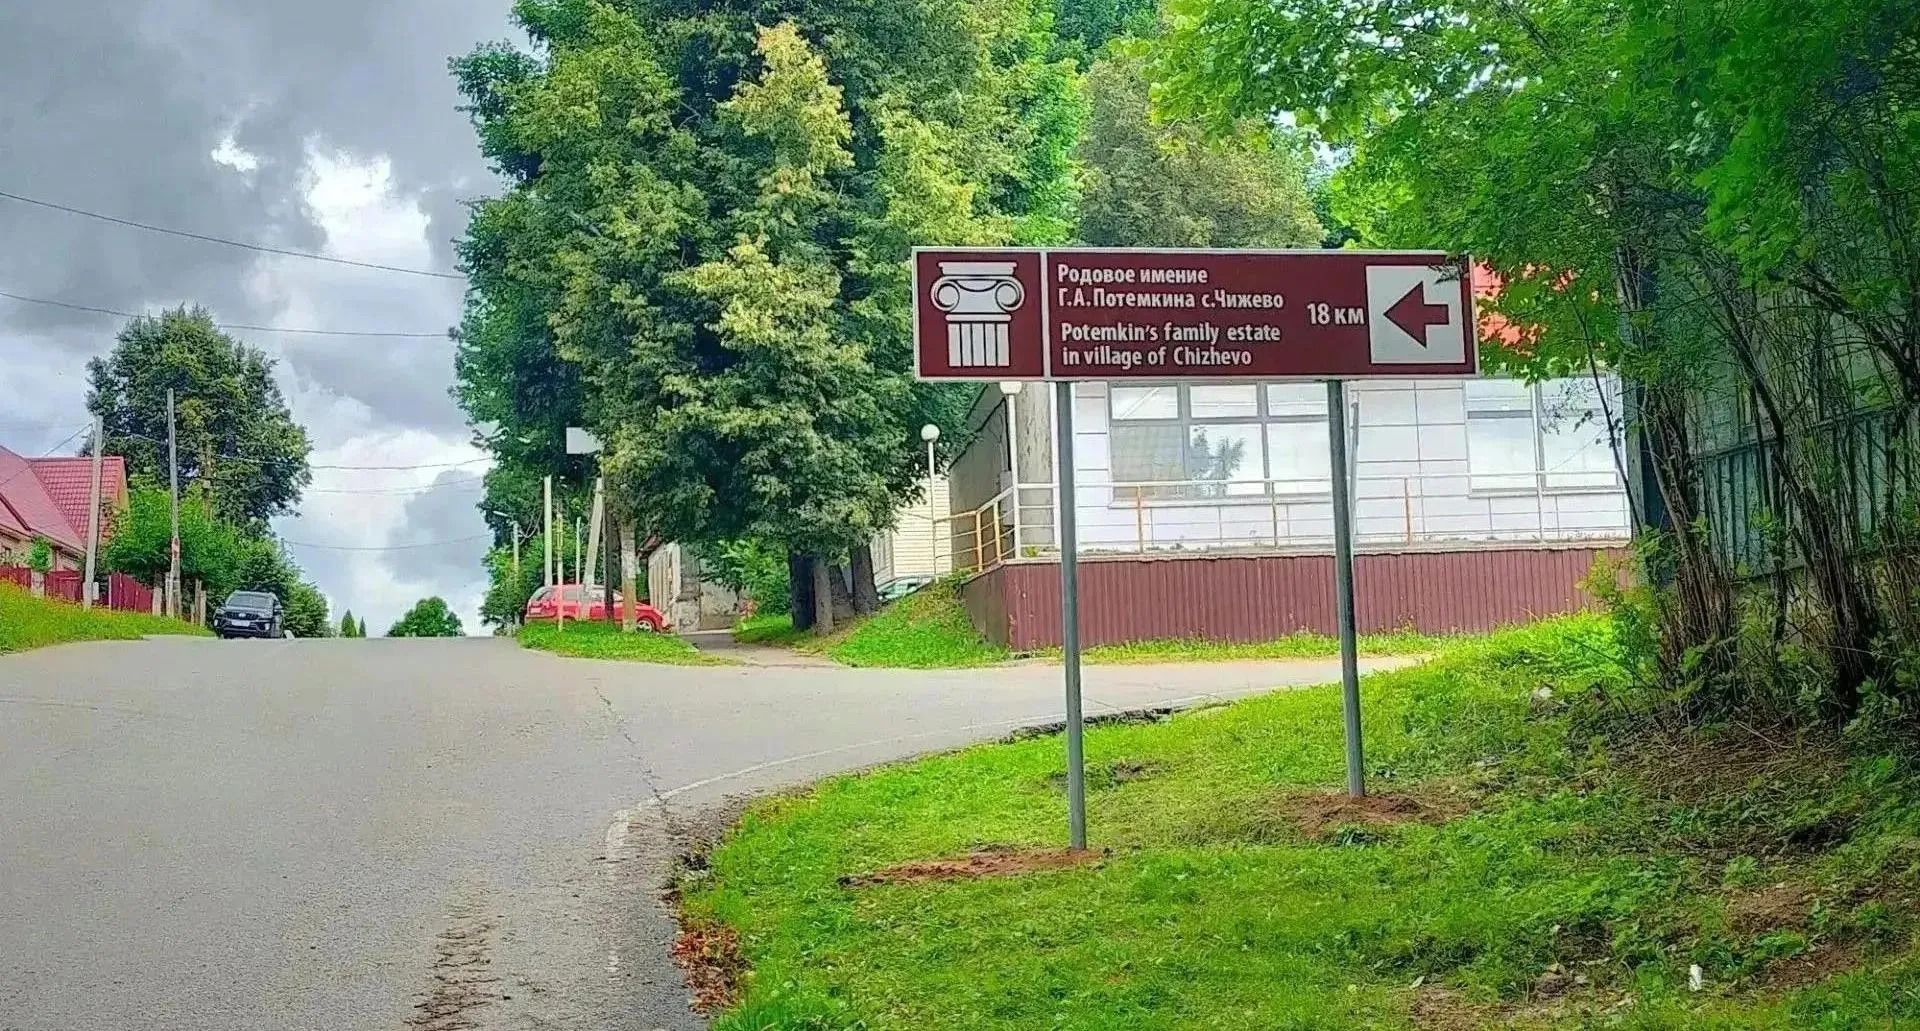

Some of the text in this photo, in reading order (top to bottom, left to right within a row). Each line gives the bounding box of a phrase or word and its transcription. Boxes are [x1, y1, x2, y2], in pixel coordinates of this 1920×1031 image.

[1057, 264, 1208, 286] Родовое имение
[1201, 289, 1284, 308] с.Чижево
[1306, 303, 1365, 325] 18 км
[1061, 321, 1281, 345] Potemkin's family estate
[1062, 346, 1252, 370] in village of Chizhevo
